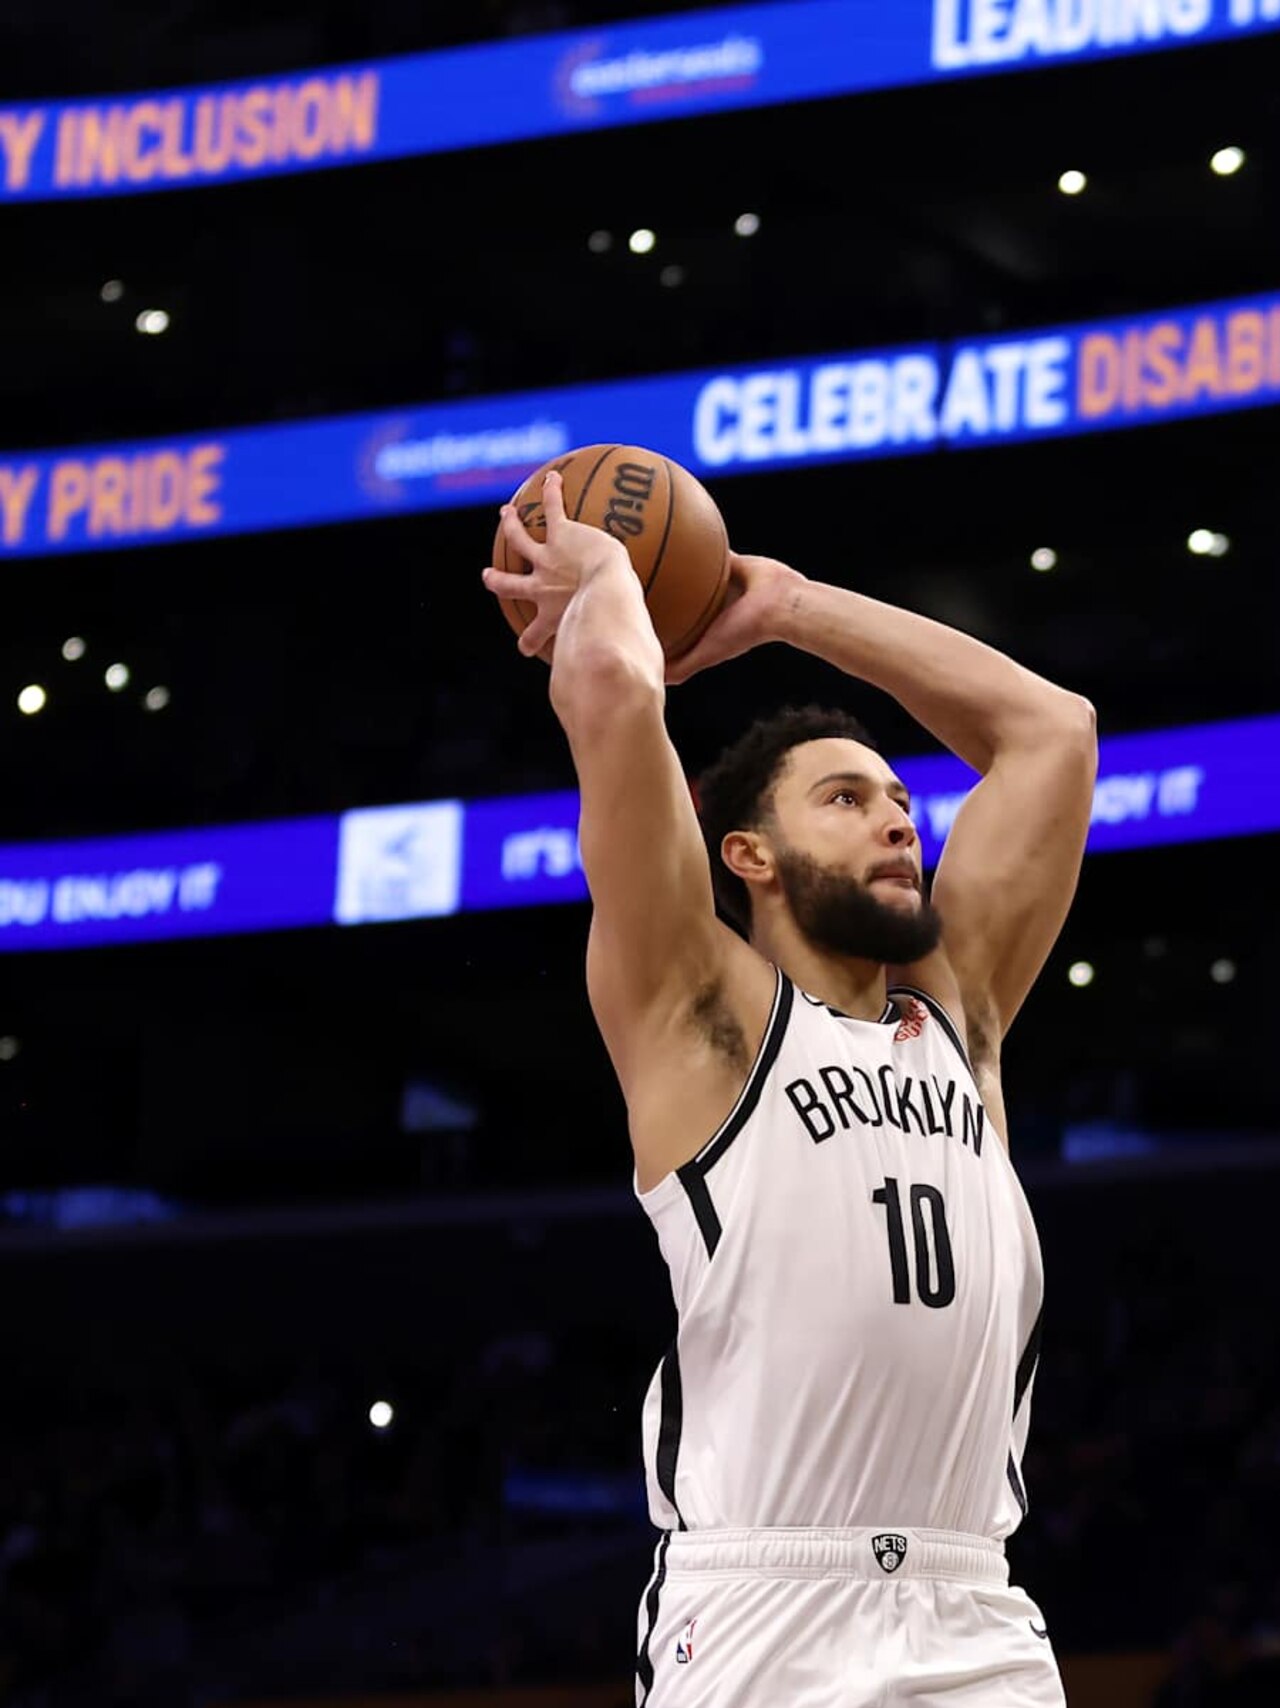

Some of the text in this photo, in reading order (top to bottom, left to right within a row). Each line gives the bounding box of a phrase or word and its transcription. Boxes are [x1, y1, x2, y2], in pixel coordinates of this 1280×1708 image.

[55, 70, 378, 189] INCLUSION
[693, 336, 1070, 466] CELEBRATE
[47, 444, 224, 543] PRIDE
[604, 462, 655, 538] Wil
[872, 1176, 956, 1309] 10
[874, 1536, 906, 1553] NETS
